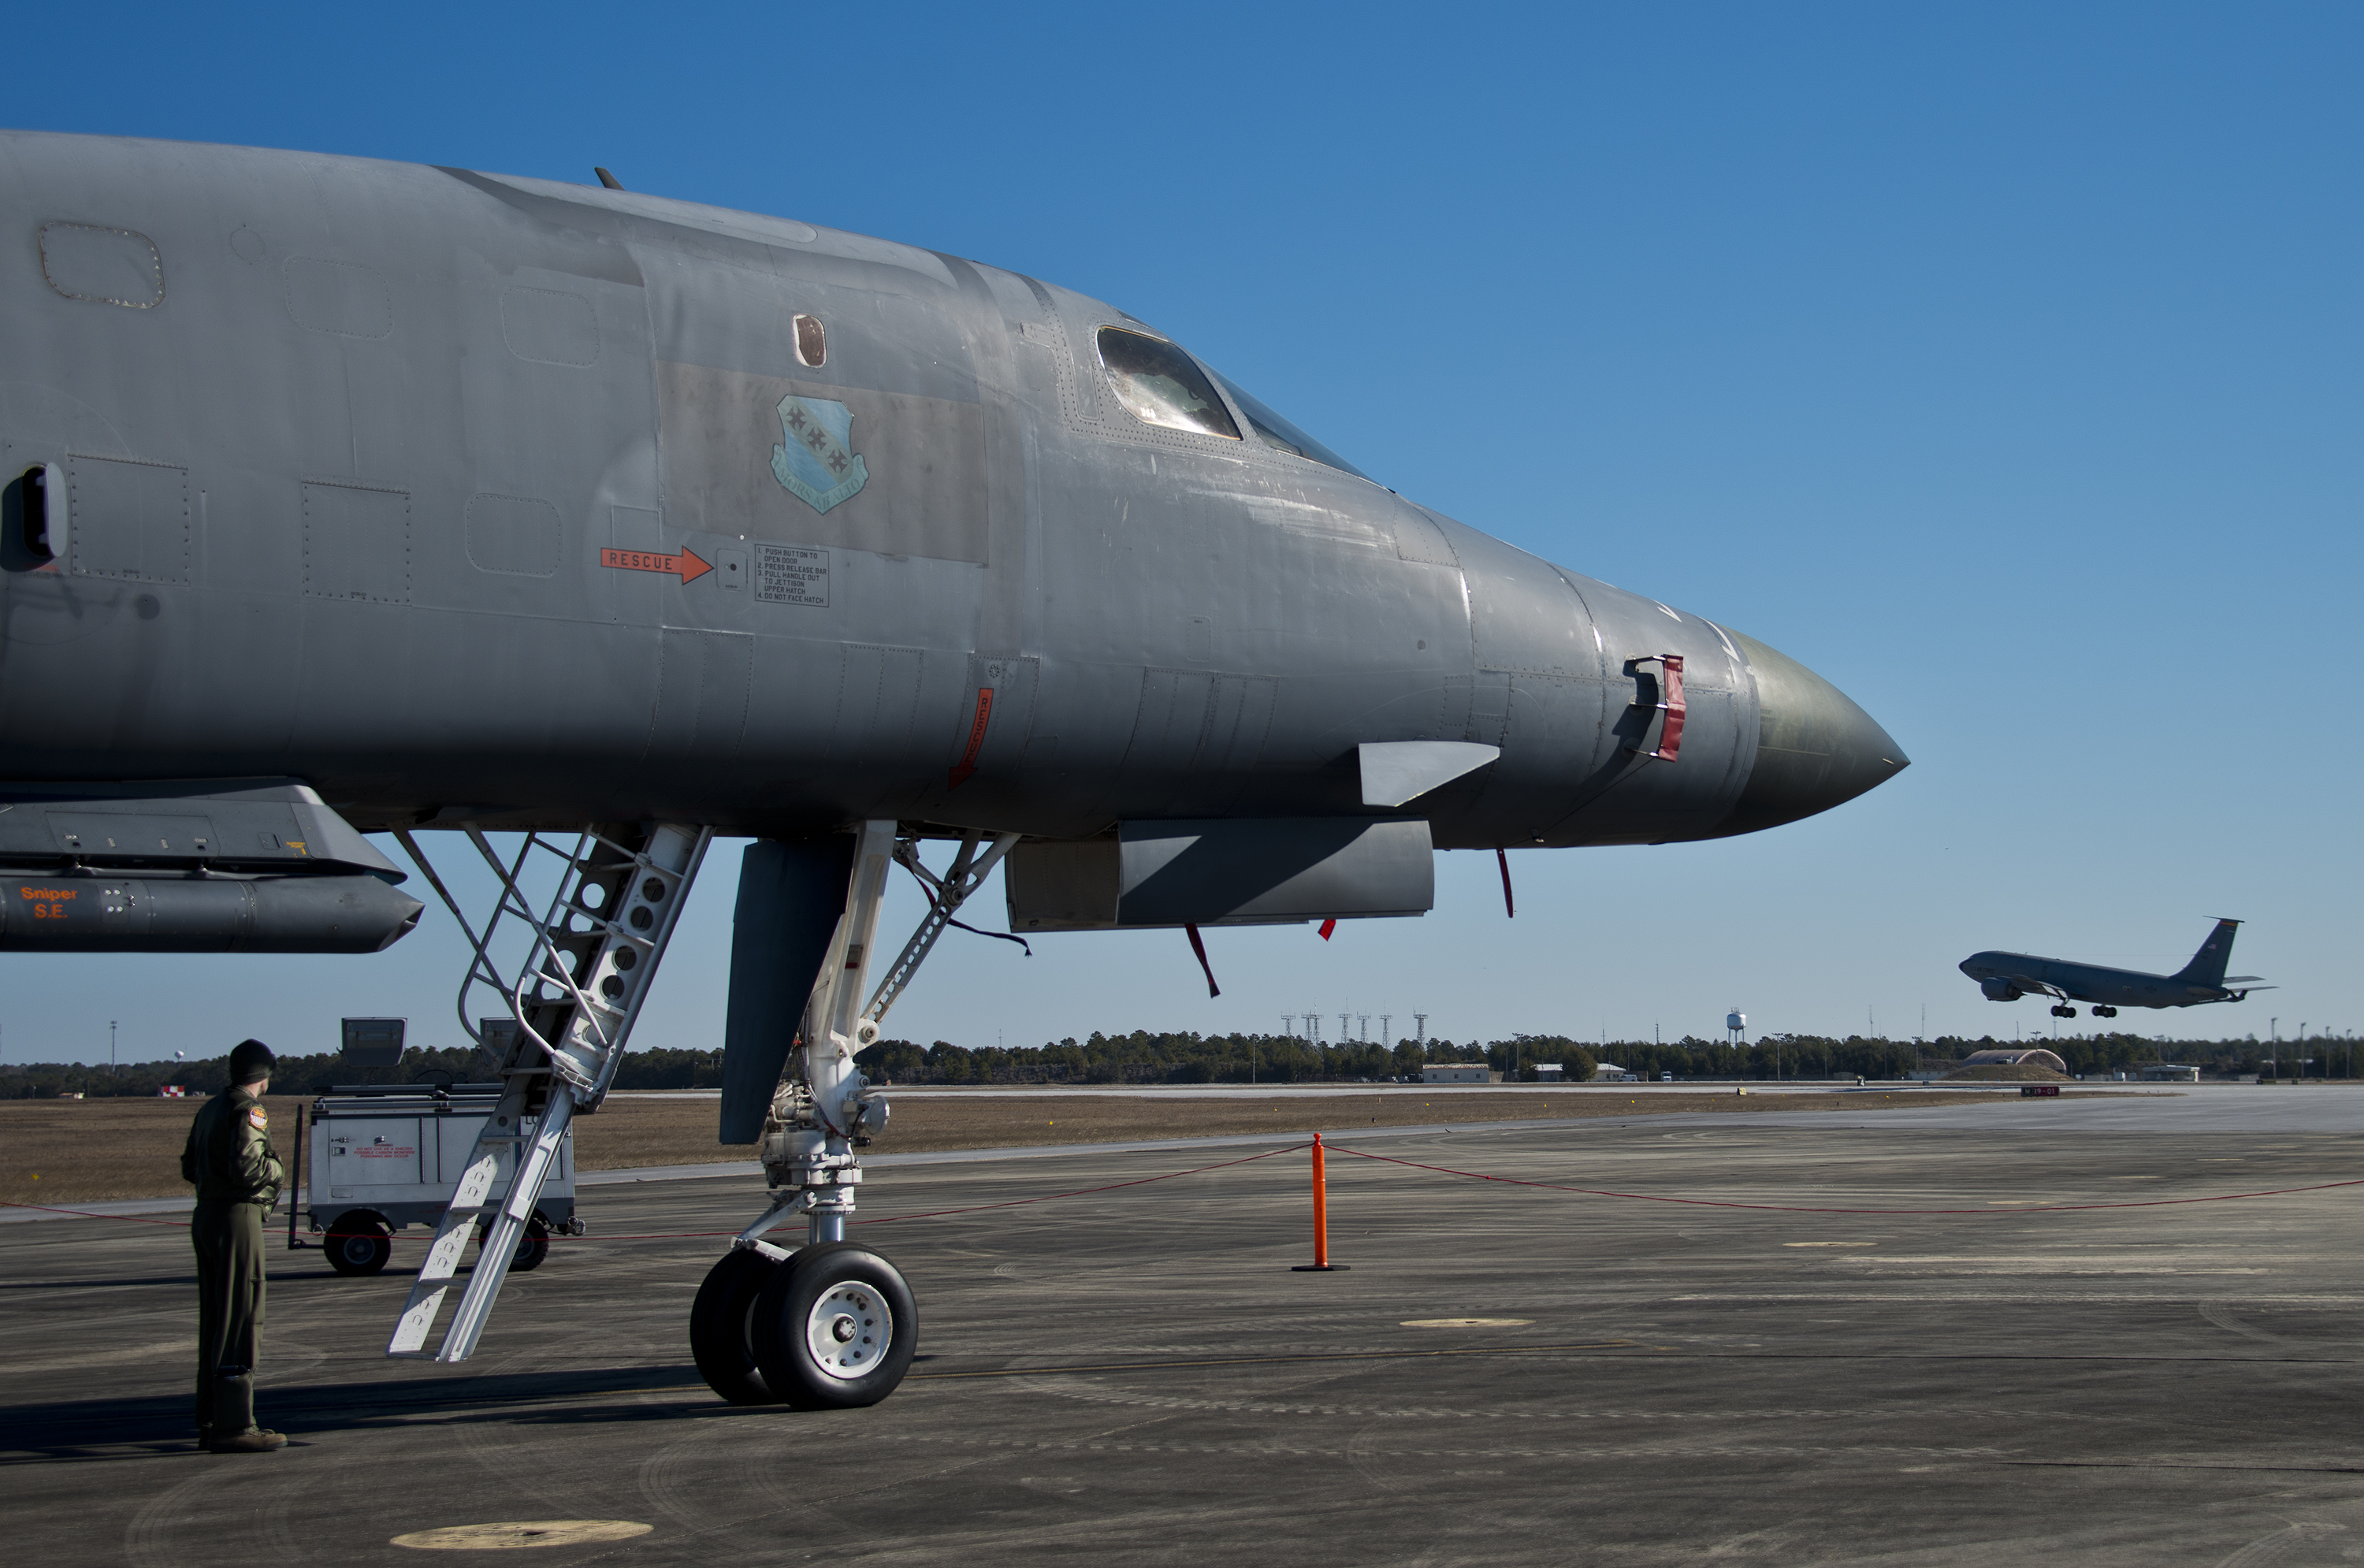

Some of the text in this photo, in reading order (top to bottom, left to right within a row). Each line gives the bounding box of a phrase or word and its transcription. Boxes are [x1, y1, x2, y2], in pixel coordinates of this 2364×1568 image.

[777, 467, 861, 510] MORS AB ALTO
[610, 552, 673, 570] RESCUE
[765, 548, 782, 556] PUSH
[783, 550, 808, 559] BUTTON
[786, 565, 814, 574] RELEASE
[965, 697, 988, 763] RESCUE
[20, 886, 78, 903] Sniper
[35, 903, 68, 920] S.E.
